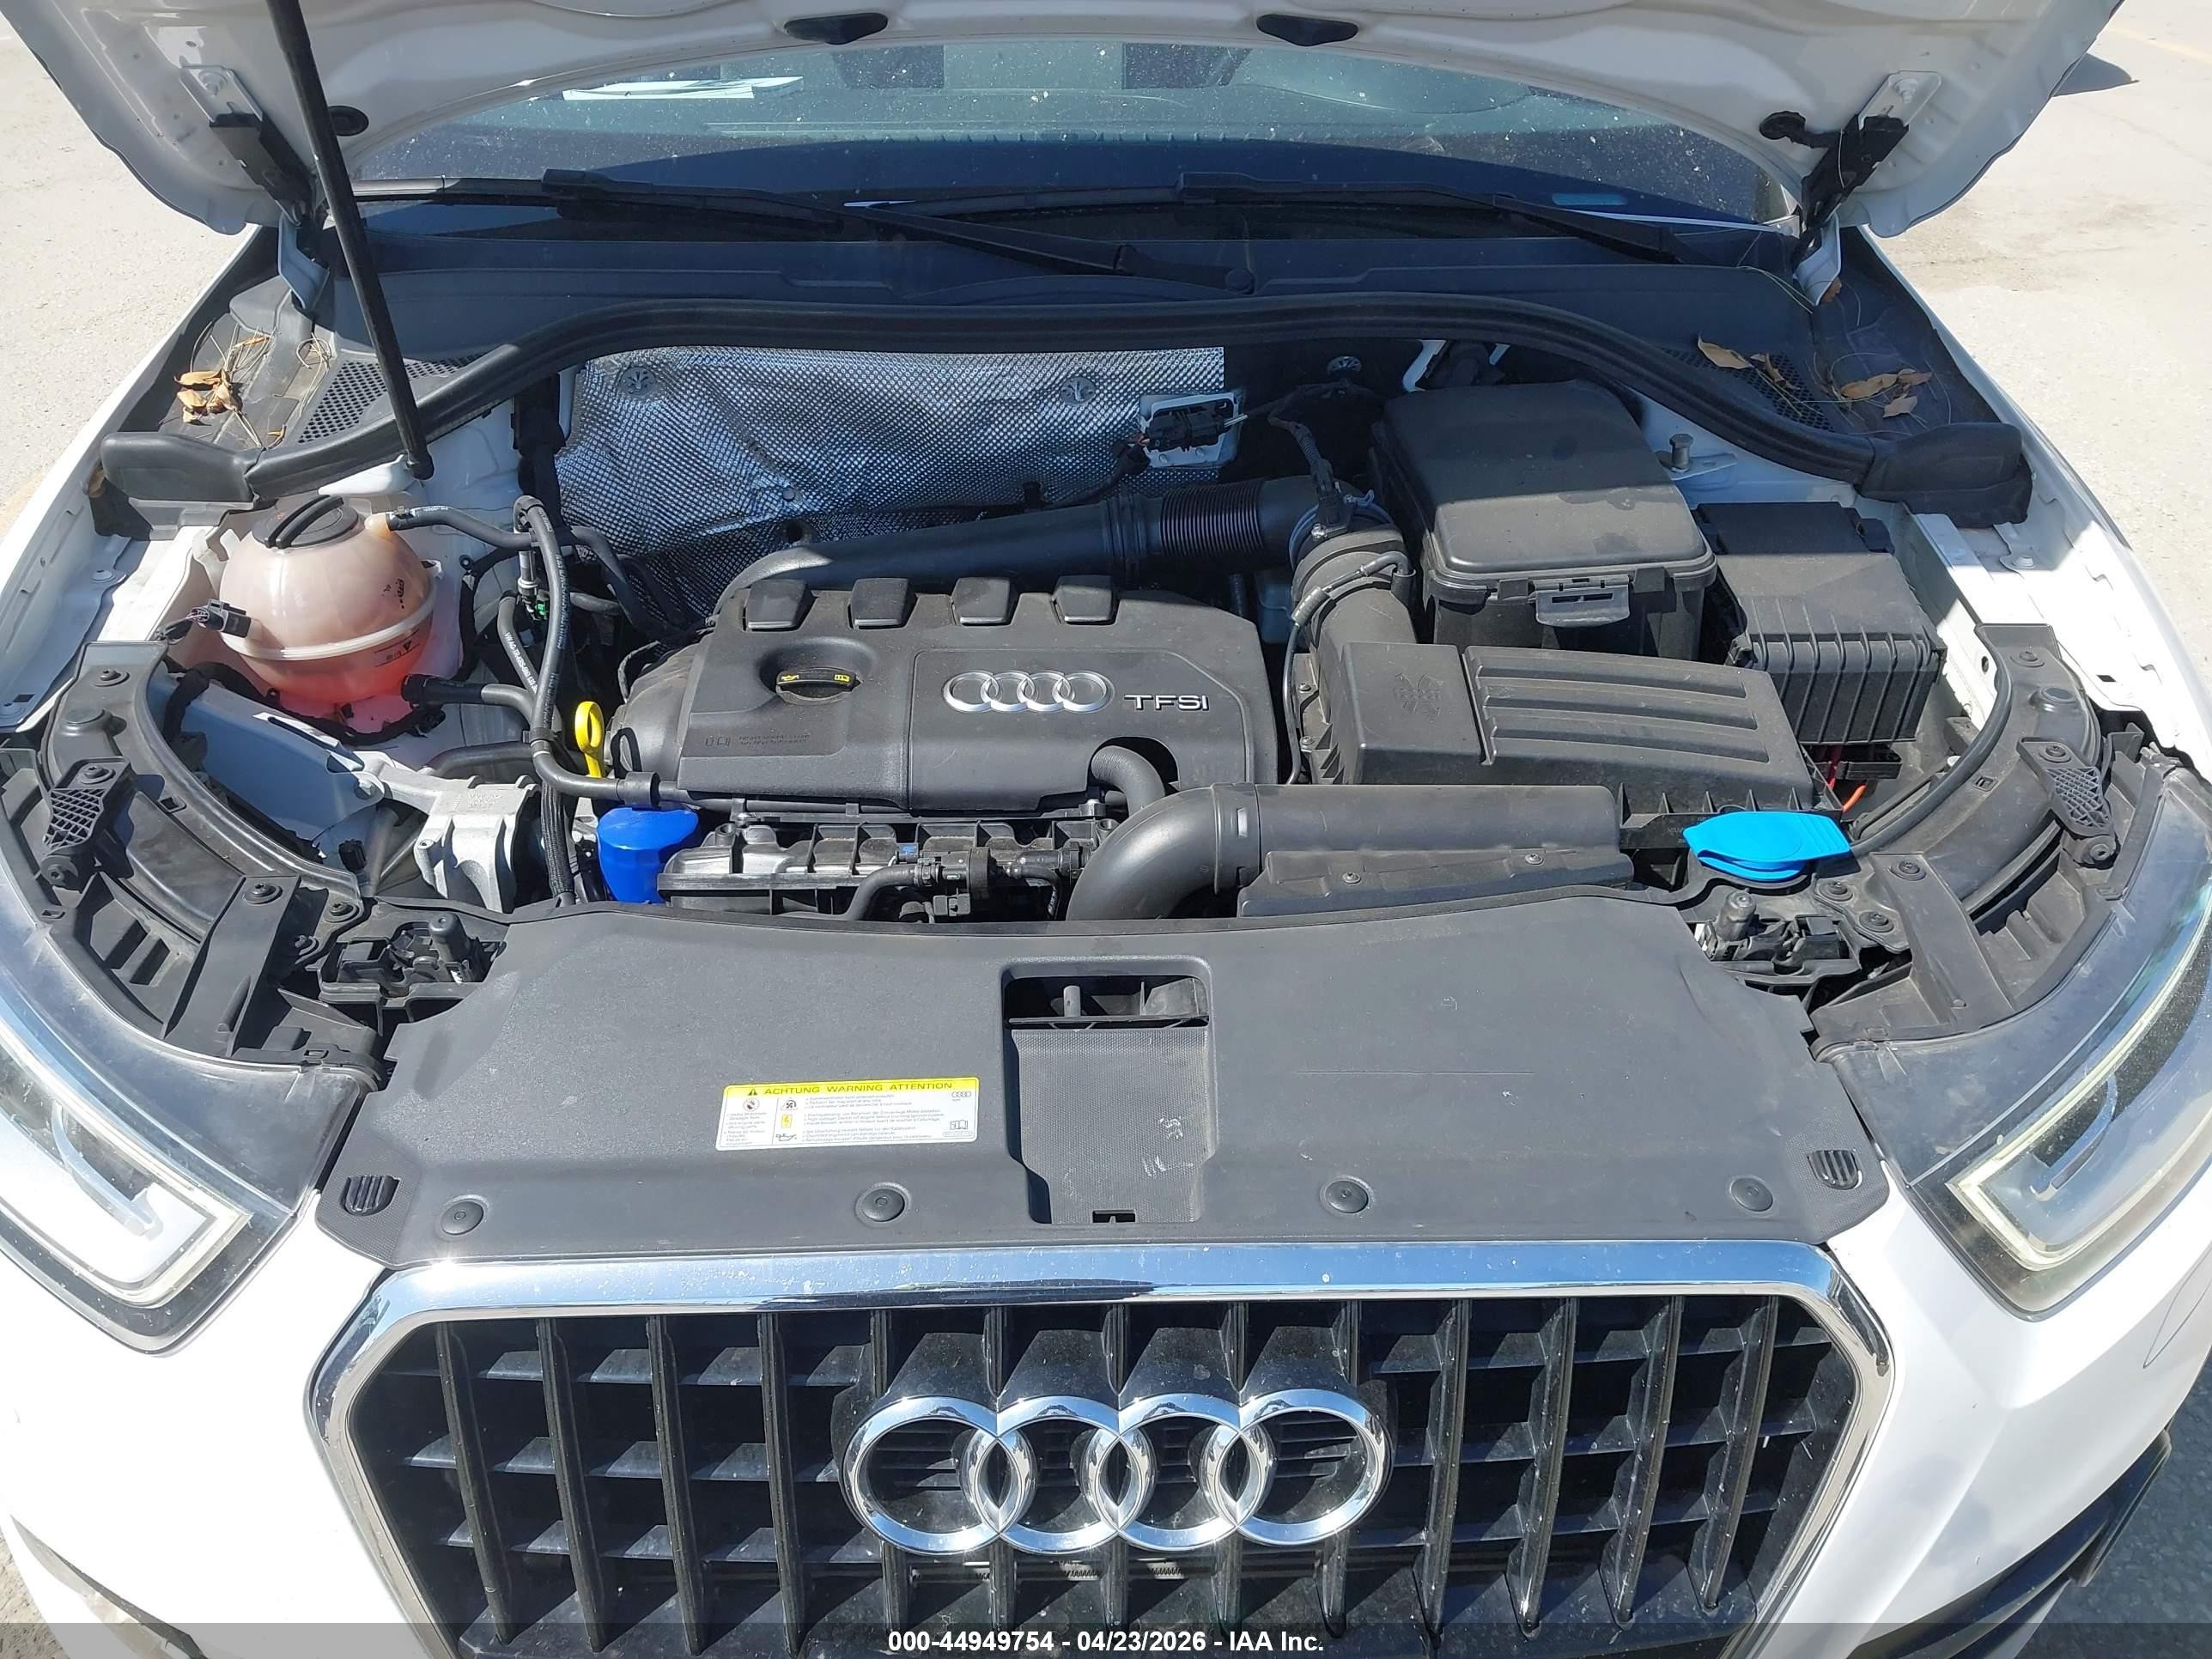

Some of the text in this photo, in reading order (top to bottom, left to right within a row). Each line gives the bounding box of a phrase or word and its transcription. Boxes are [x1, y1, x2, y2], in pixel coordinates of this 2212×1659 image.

[1124, 694, 1209, 711] TFSI
[764, 1086, 820, 1095] ACHTUNG
[890, 1082, 952, 1091] ATTENTION
